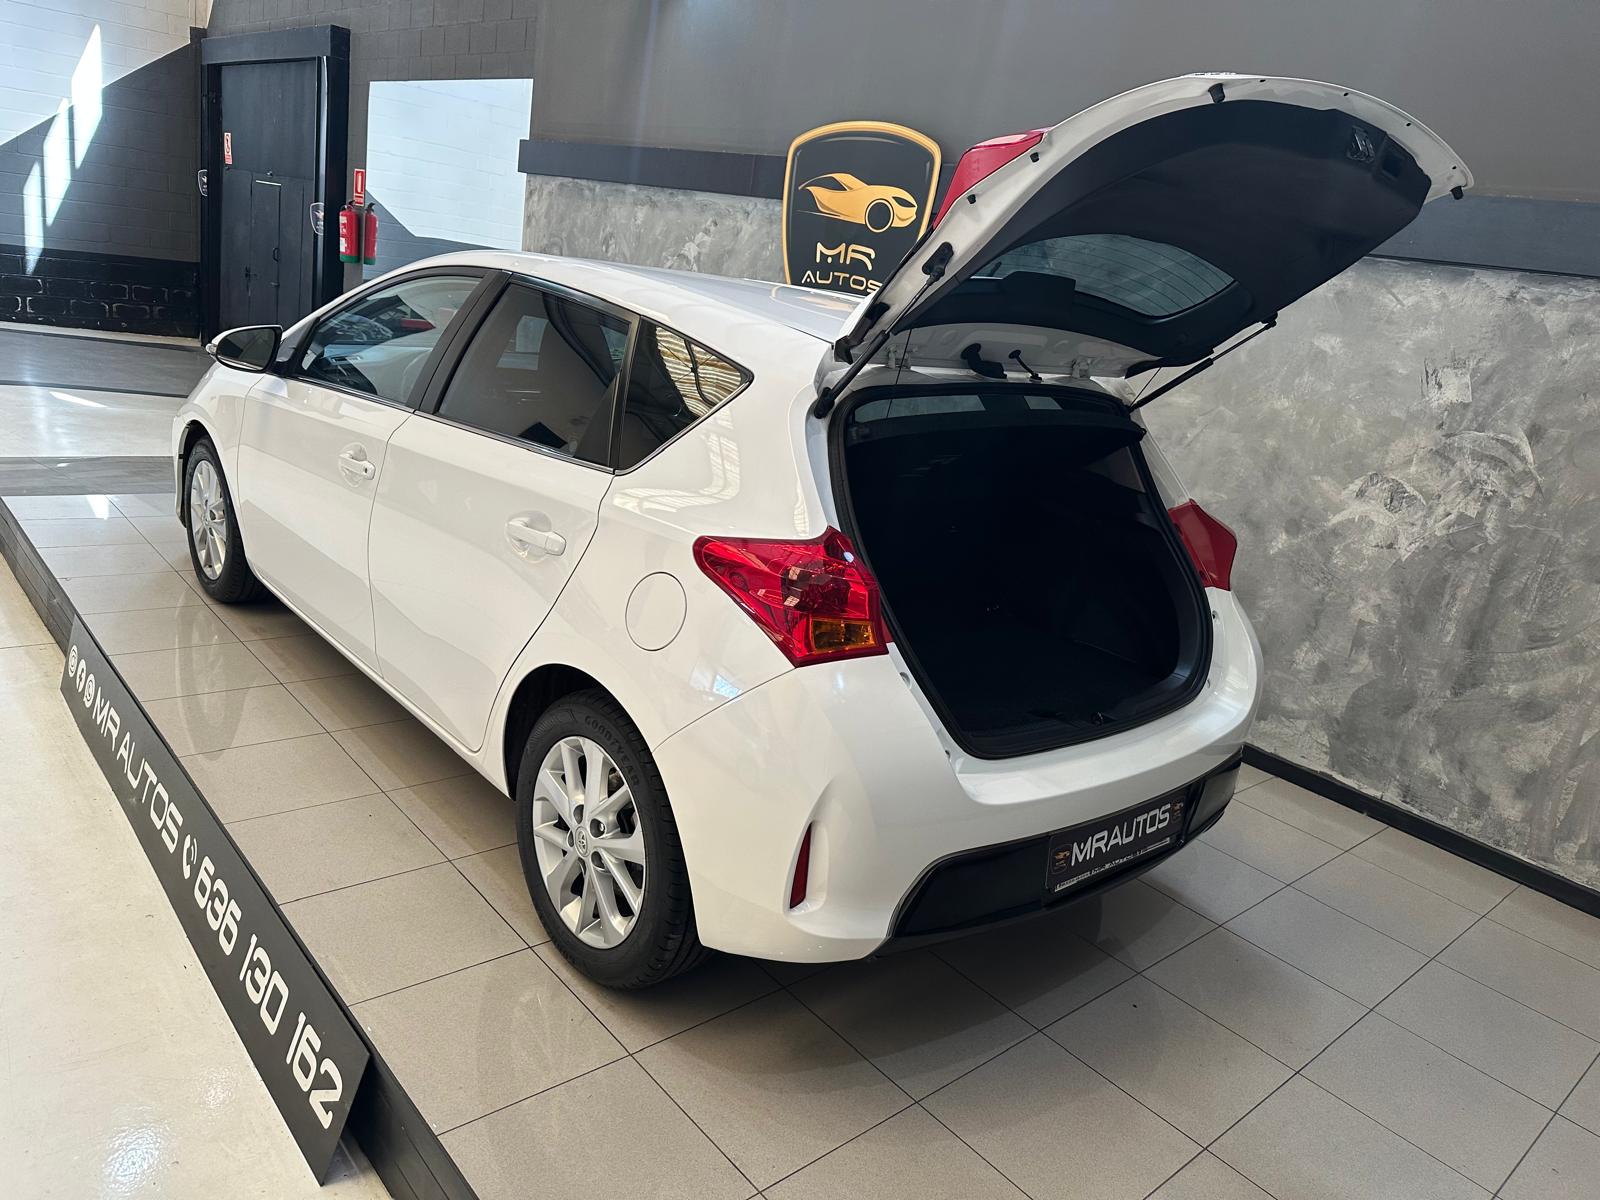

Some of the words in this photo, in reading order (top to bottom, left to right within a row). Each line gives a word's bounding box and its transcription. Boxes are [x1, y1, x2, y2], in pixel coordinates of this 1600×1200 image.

[815, 242, 876, 271] MR
[801, 270, 884, 294] AUTOS
[92, 685, 121, 752] MR
[116, 730, 184, 854] AUTOS
[194, 855, 242, 956] 636
[238, 933, 290, 1036] 130
[285, 1011, 344, 1129] 162
